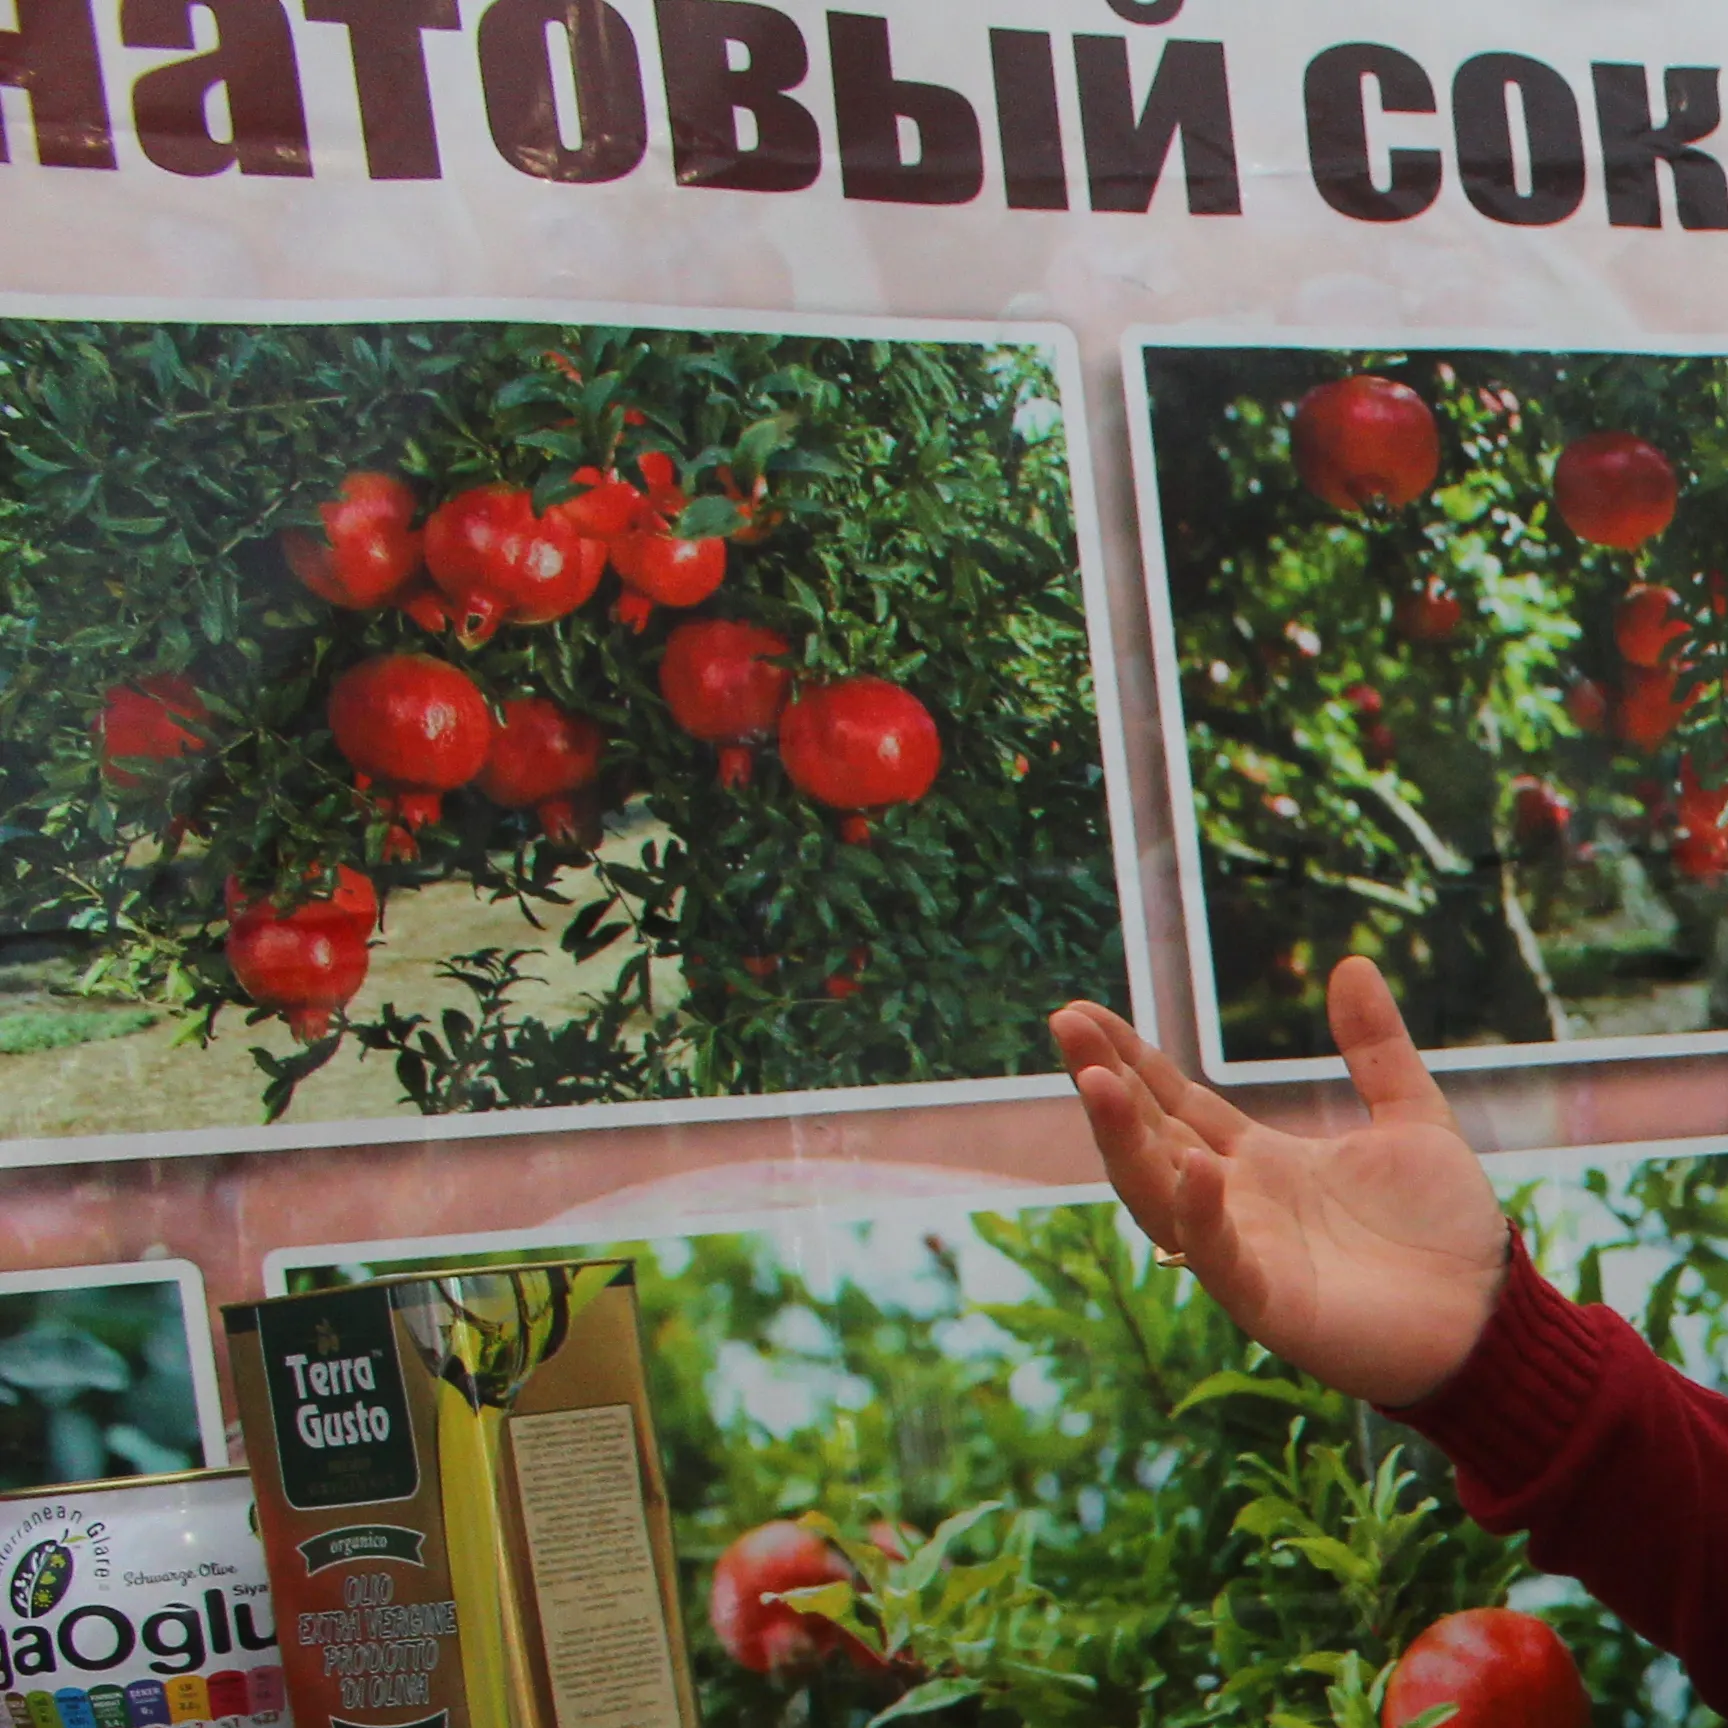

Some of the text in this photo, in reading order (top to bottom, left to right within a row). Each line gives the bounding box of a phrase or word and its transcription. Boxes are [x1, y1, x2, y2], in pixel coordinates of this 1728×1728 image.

[284, 1353, 376, 1400] Terra
[296, 1400, 391, 1449] Gusto
[342, 1572, 395, 1608] OLIO
[297, 1601, 458, 1646] EXTRA VERGINE
[323, 1638, 440, 1677] PRODOTTO
